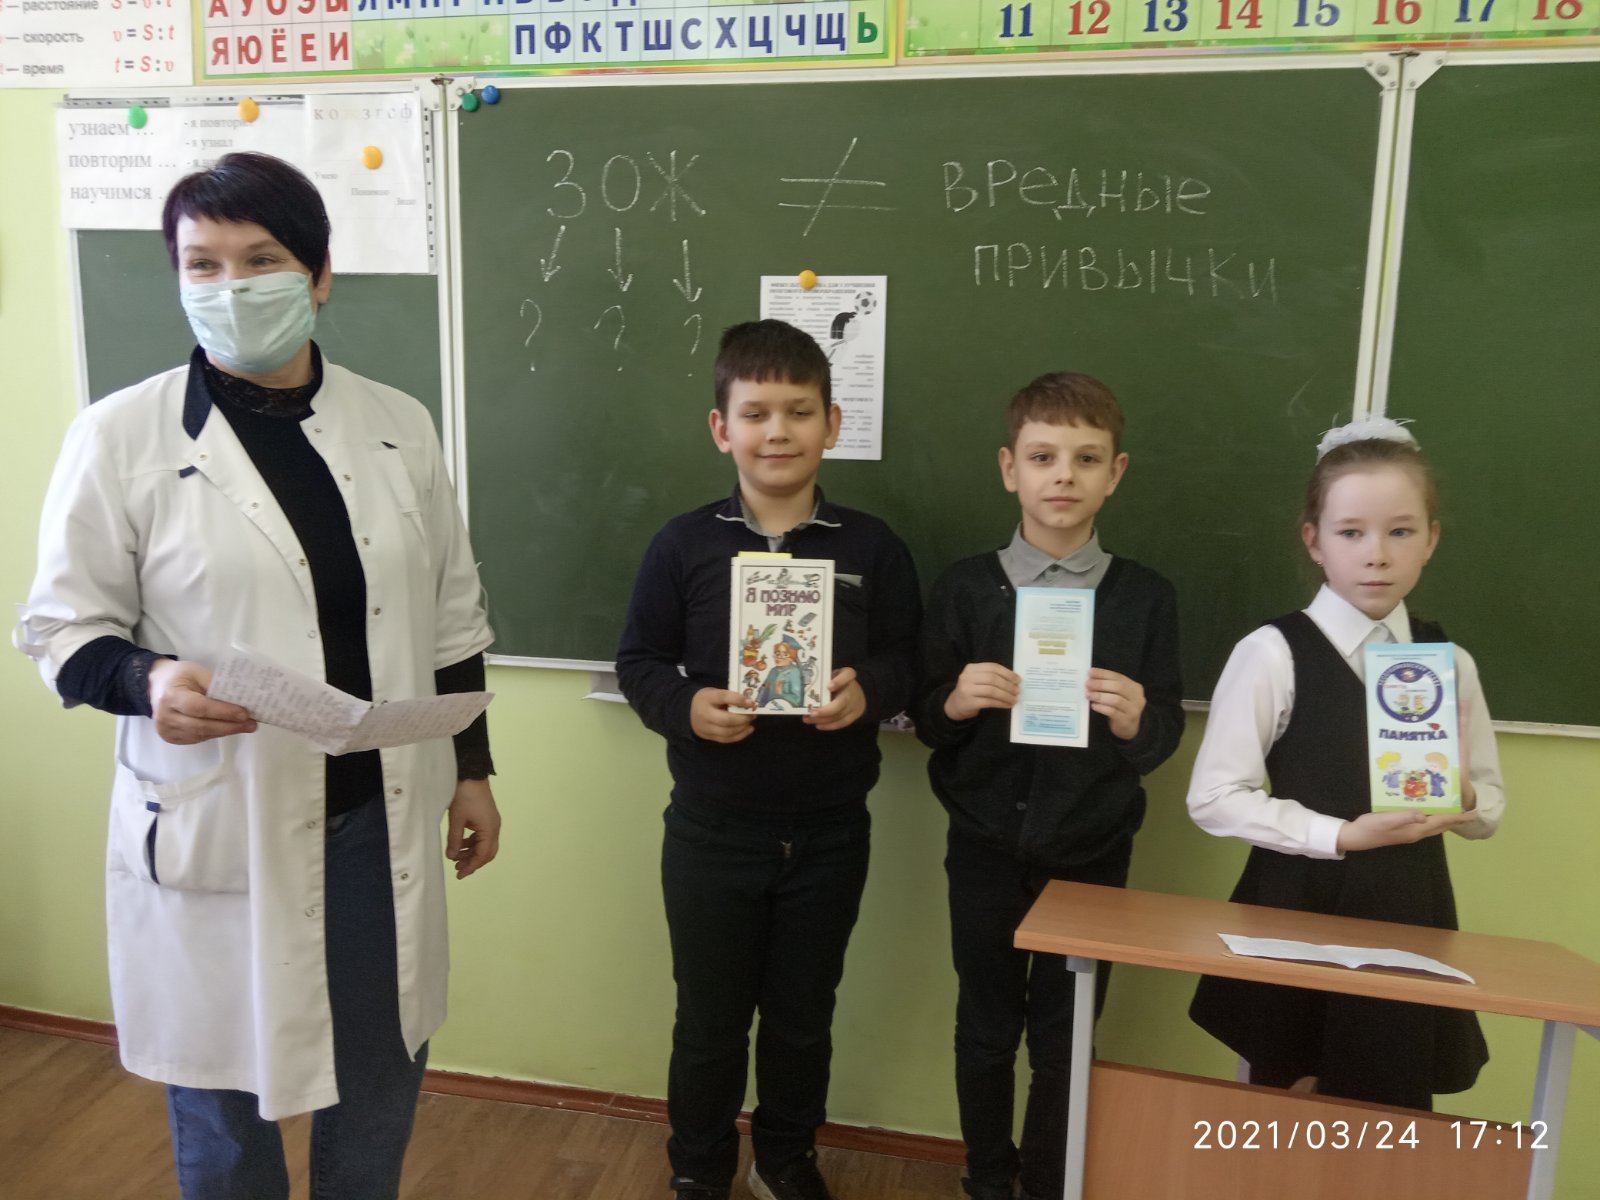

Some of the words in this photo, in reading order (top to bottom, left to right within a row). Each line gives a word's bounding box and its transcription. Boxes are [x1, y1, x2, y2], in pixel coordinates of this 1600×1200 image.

[22, 0, 99, 13] расстояние
[999, 2, 1034, 38] 11
[1068, 0, 1111, 35] 12
[1143, 0, 1189, 32] 13
[1216, 0, 1263, 30] 14
[1293, 0, 1340, 27] 15
[1372, 0, 1422, 25] 16
[23, 33, 84, 46] скорость
[22, 64, 65, 77] время
[68, 123, 130, 140] узнаем
[68, 154, 152, 172] повторим
[70, 187, 152, 204] научимся
[745, 587, 757, 604] Я
[760, 588, 822, 605] ПОЗНАЮ
[765, 604, 798, 617] МИР
[1378, 728, 1449, 742] ПАМЯТКА
